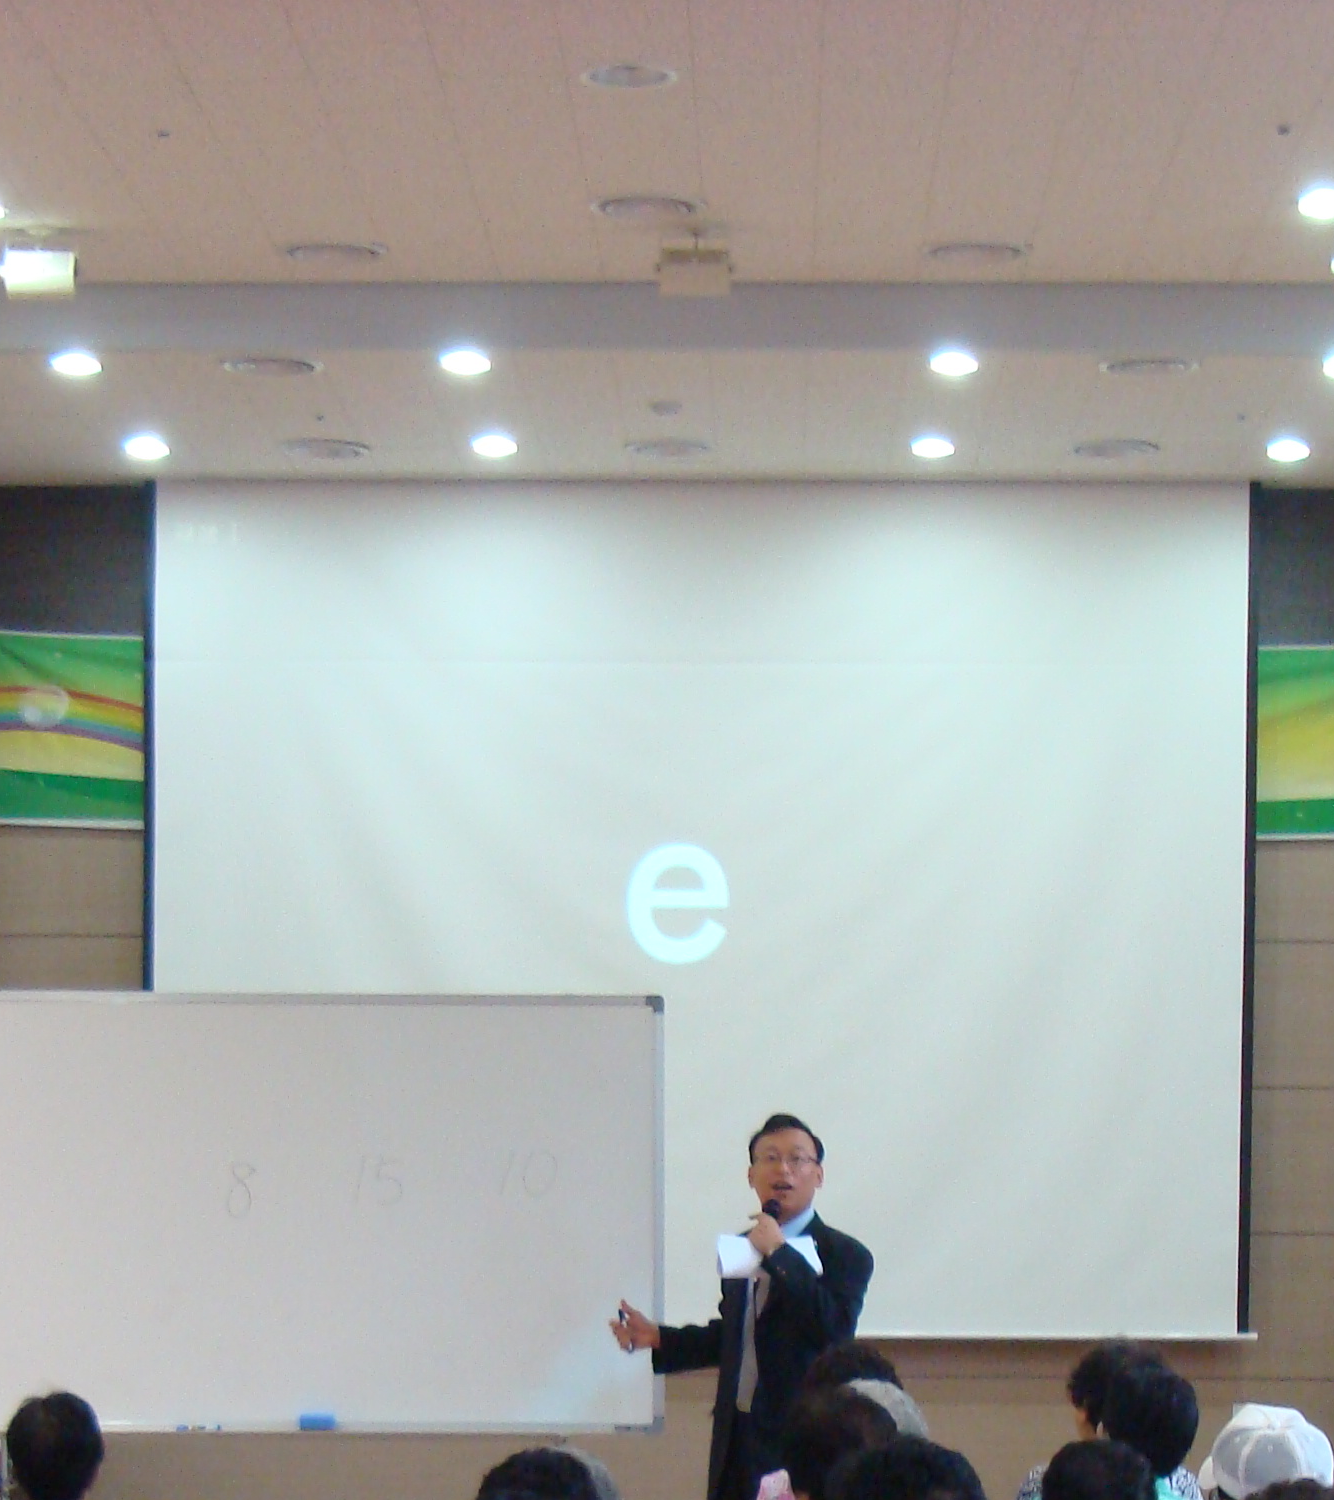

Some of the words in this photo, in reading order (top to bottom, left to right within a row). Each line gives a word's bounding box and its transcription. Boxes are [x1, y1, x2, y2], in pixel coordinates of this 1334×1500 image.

[626, 842, 730, 965] e
[224, 1161, 258, 1220] 8
[351, 1153, 405, 1209] 15
[498, 1149, 560, 1199] 10
